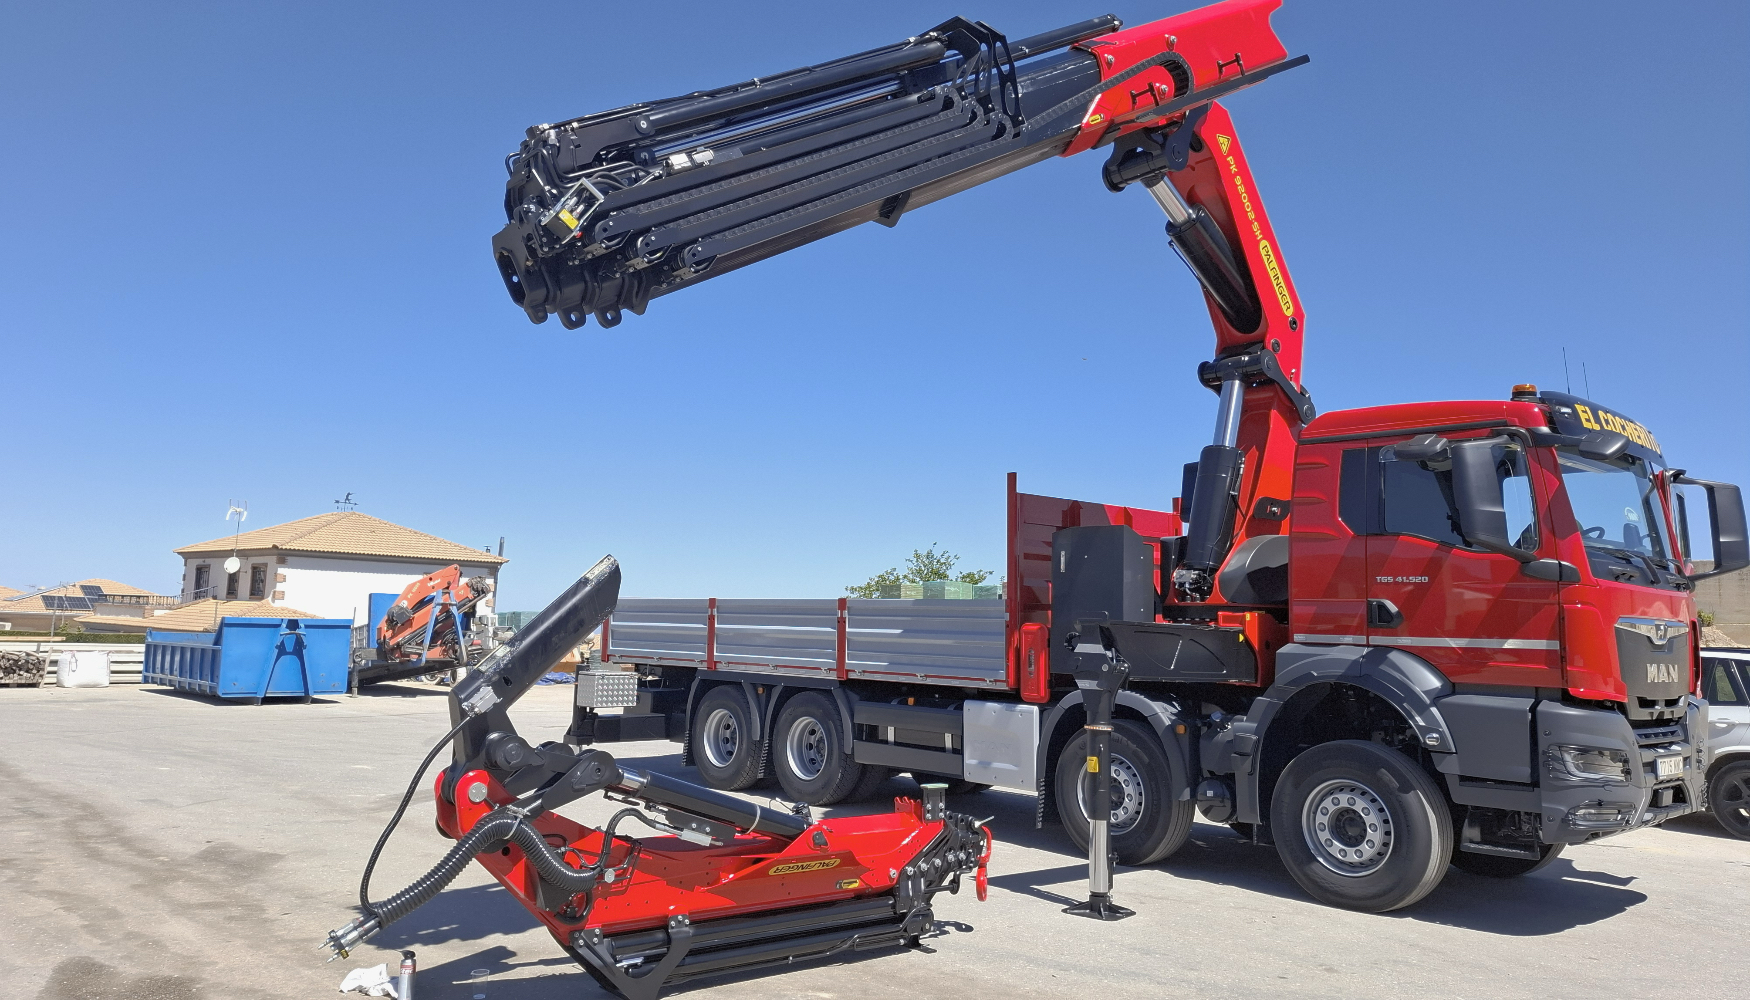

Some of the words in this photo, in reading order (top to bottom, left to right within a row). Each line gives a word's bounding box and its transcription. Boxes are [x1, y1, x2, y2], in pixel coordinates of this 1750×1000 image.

[1226, 155, 1238, 173] PK
[1261, 244, 1291, 313] PALFINGER
[1574, 403, 1601, 431] EL
[1646, 663, 1679, 683] MAN
[772, 859, 838, 874] PALFINGER
